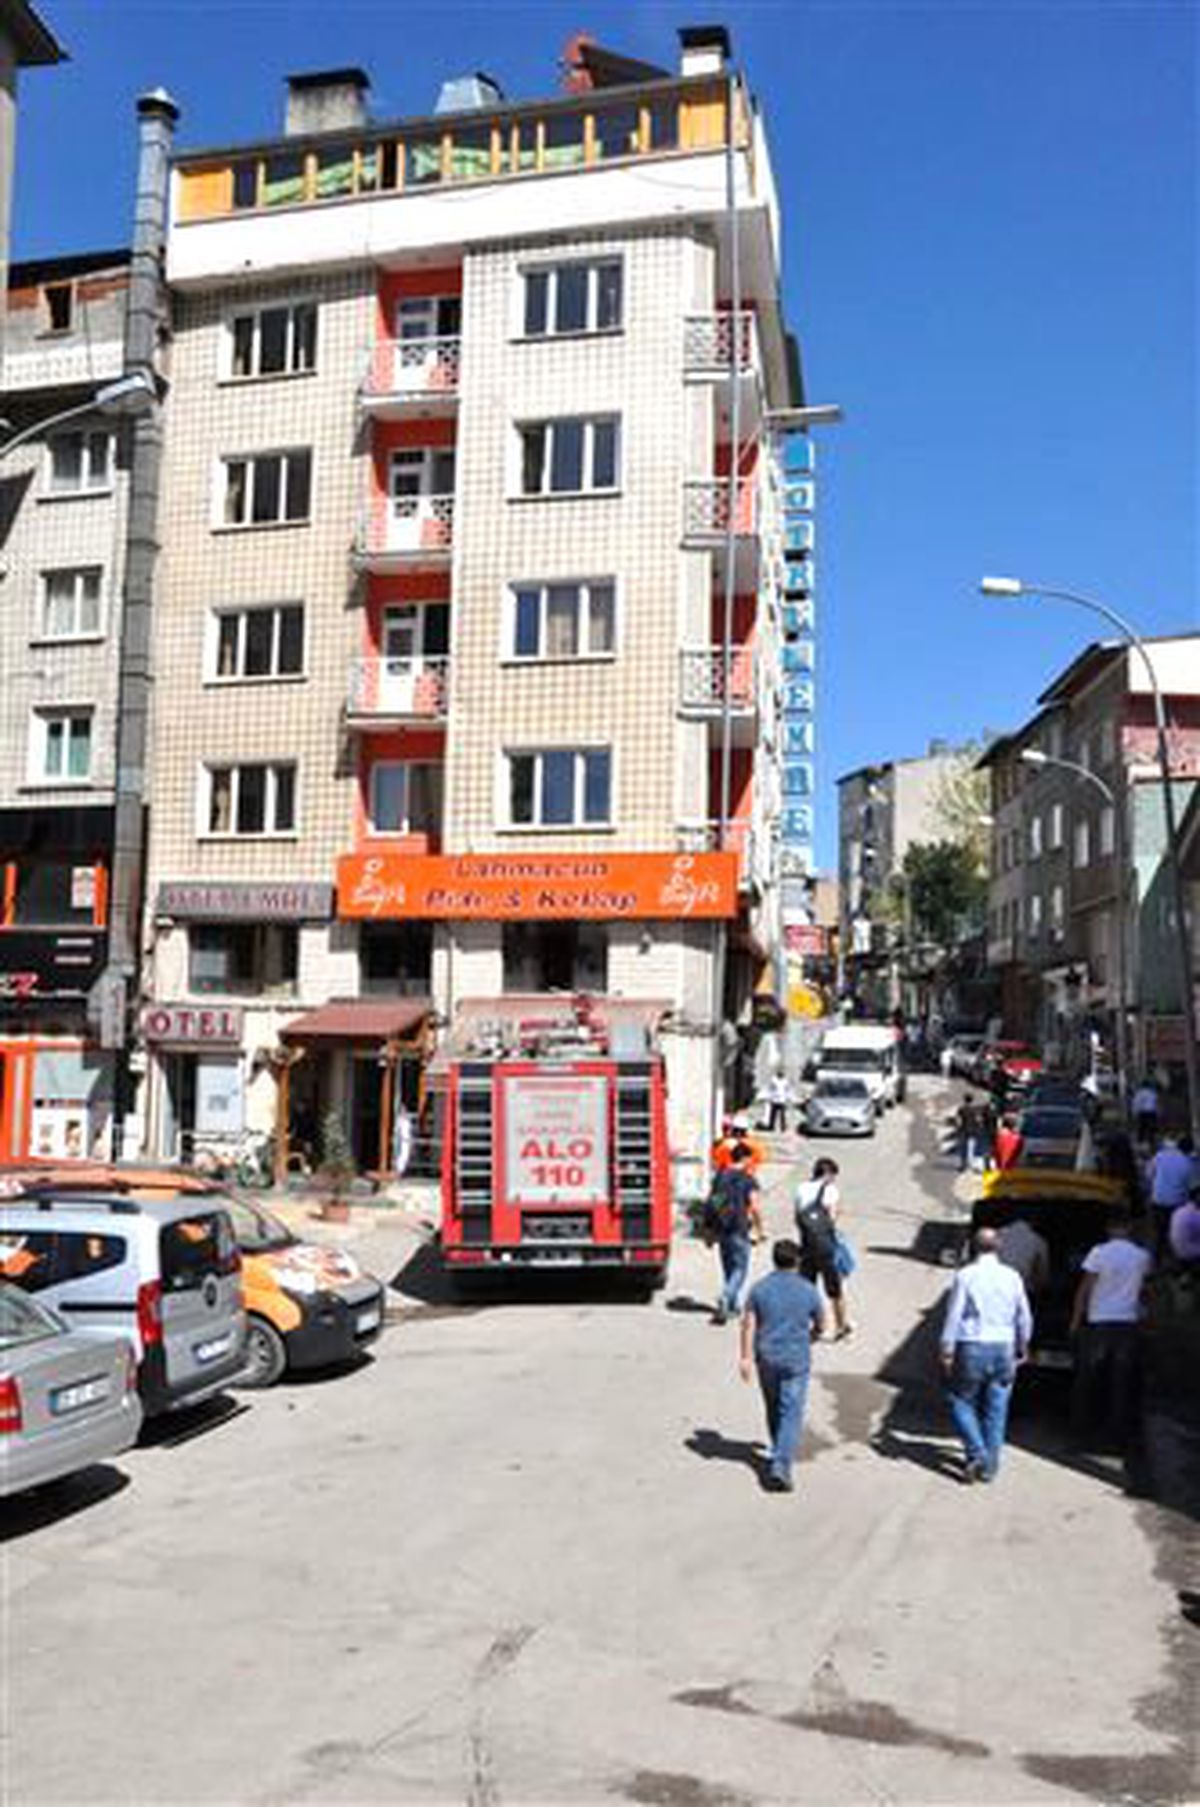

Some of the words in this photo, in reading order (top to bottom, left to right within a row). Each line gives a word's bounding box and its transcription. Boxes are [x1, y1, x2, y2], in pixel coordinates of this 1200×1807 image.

[149, 1010, 235, 1037] OTEL
[520, 1138, 593, 1159] ALO
[530, 1165, 585, 1187] 110
